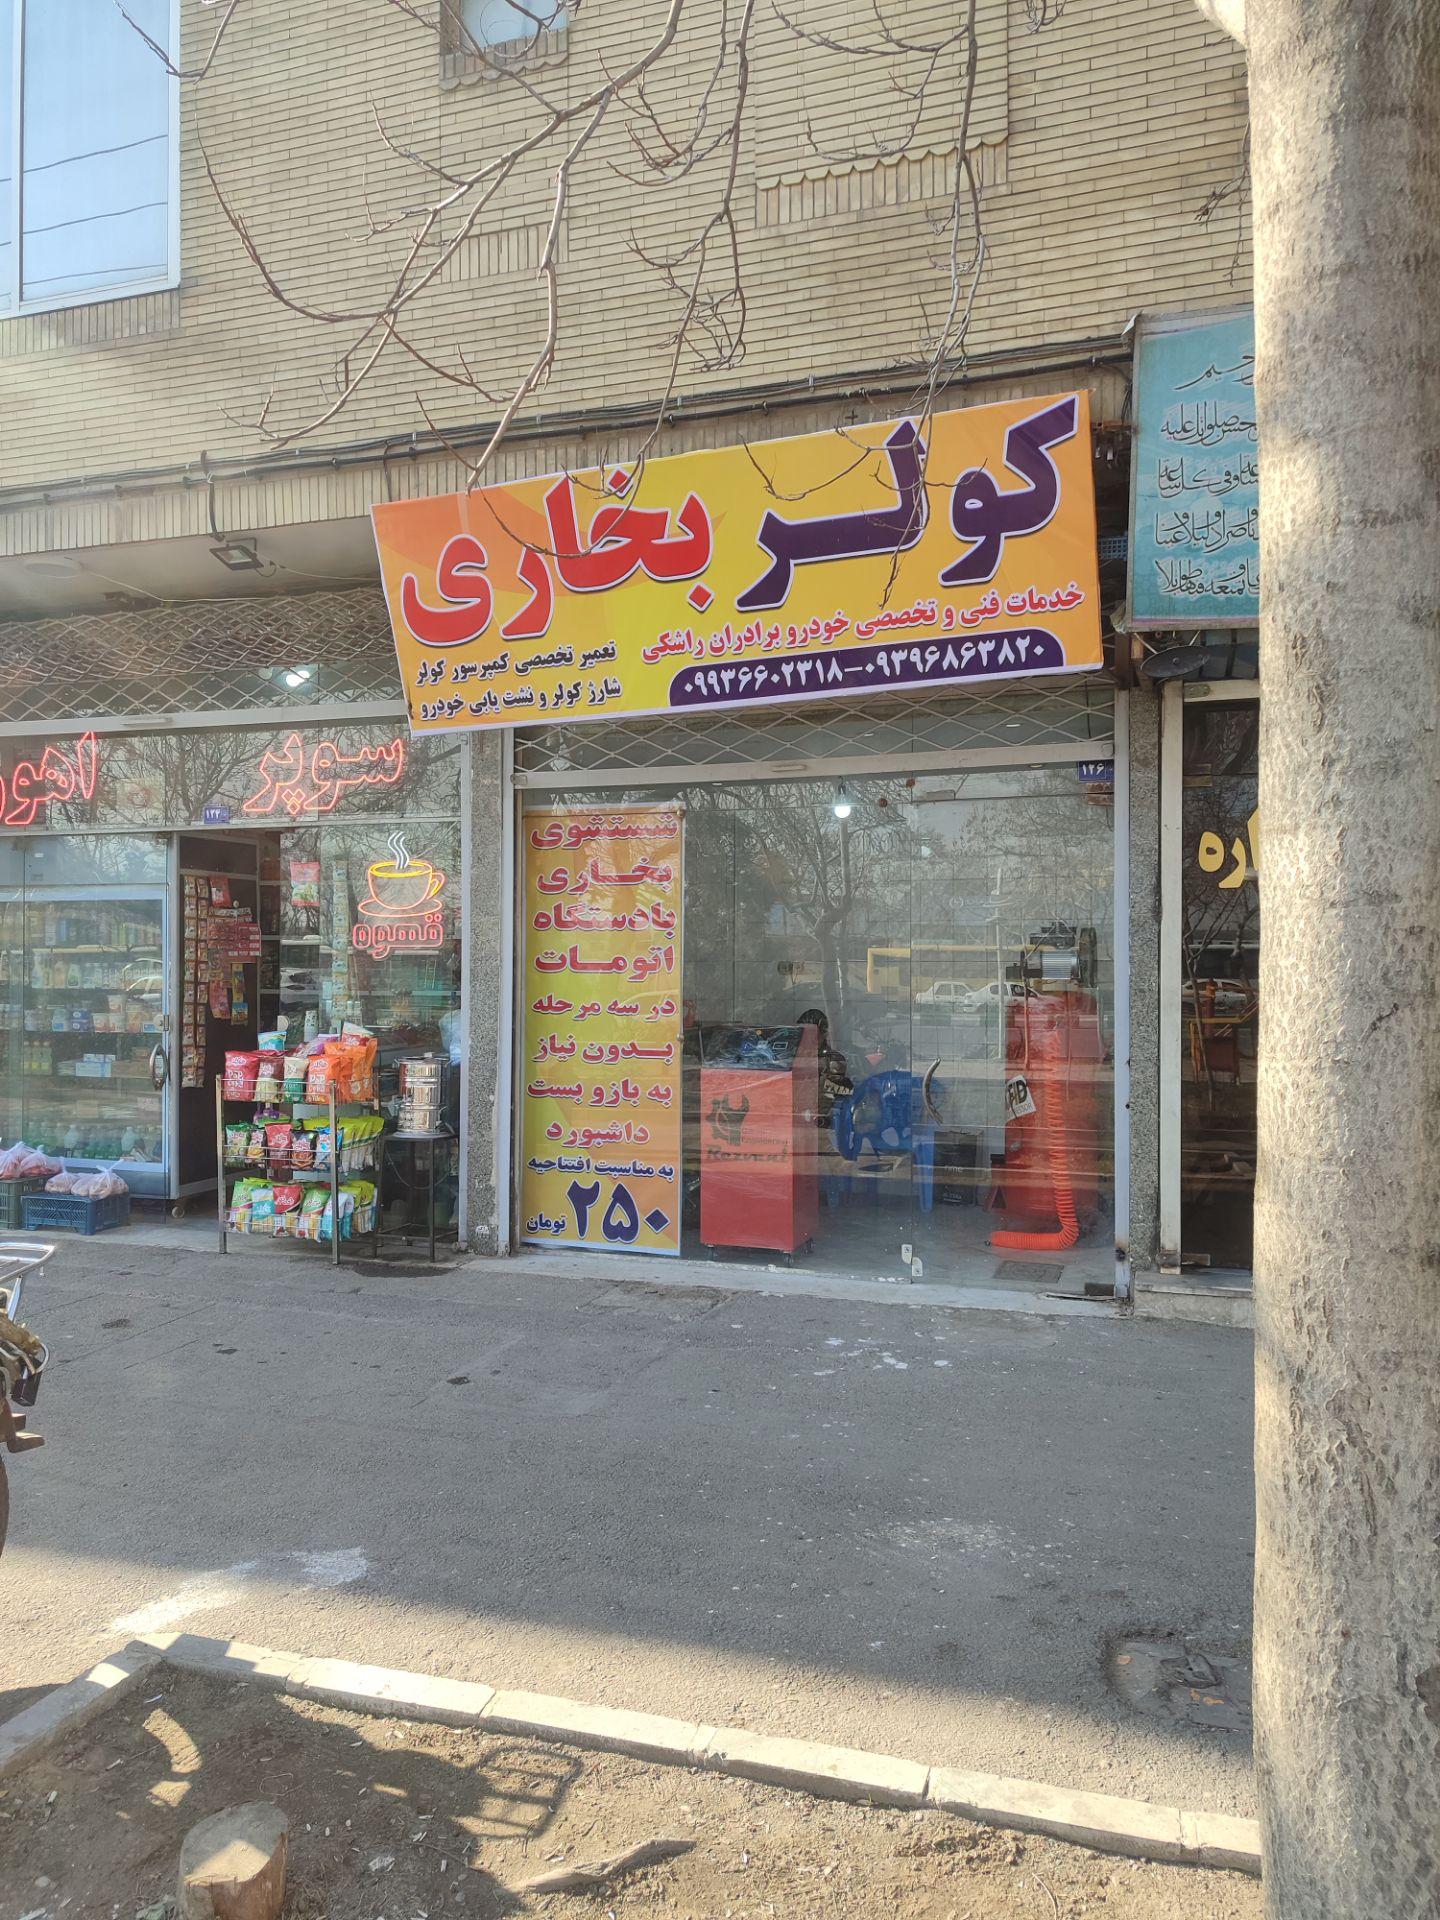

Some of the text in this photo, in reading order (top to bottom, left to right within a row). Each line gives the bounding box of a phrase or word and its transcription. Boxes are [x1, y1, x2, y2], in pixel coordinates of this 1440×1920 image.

[402, 395, 1080, 646] کولر بخاری
[642, 583, 1085, 663] خدمات فنی و تخصصی خودرو برادران راشکی
[416, 640, 617, 686] تعمیر تخصصی کمپرسور کولر
[420, 694, 464, 721] خودرو
[539, 692, 549, 708] و
[552, 681, 582, 707] کولر
[588, 677, 622, 703] شارژ
[243, 731, 405, 816] سوپر
[531, 813, 679, 849] شستشوی
[536, 856, 673, 895] بخاری
[352, 913, 446, 960] قهوه
[534, 944, 674, 982] اتومات
[532, 993, 677, 1022] در سه مرحله
[533, 1032, 674, 1066] بدون نیاز
[647, 1082, 673, 1108] به
[546, 1120, 650, 1148] داشبورد
[528, 1155, 674, 1183] به مناسبت افتتاحیه
[526, 1179, 671, 1244] ۲۵۰ تومان
